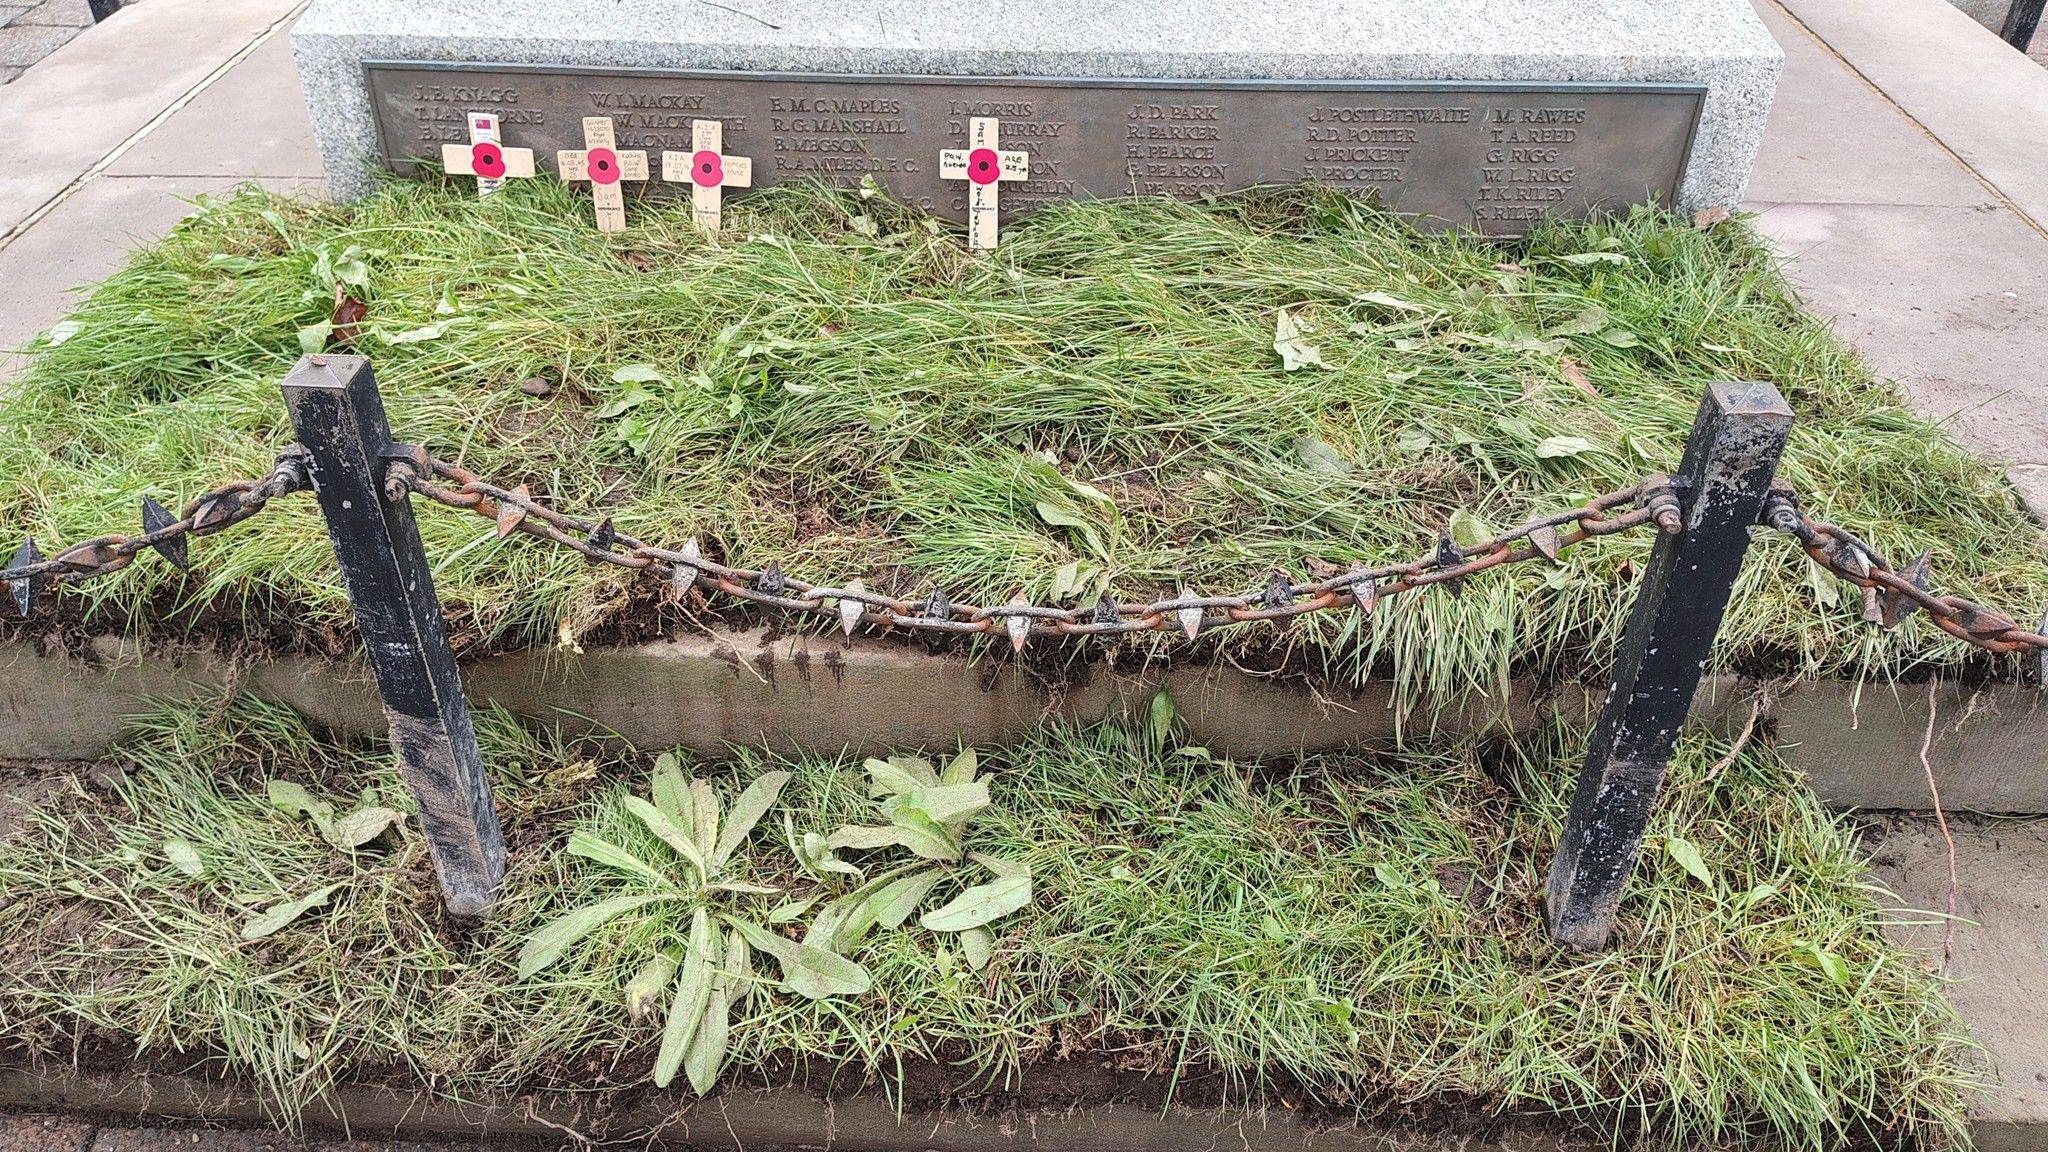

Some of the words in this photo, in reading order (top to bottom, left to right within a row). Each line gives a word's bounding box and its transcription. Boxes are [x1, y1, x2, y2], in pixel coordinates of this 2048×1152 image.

[451, 86, 519, 103] KNAGG
[632, 94, 706, 110] MACKAY
[832, 98, 901, 115] MAPLES
[963, 100, 1033, 117] MORRIS
[1170, 104, 1220, 120] PARK
[433, 106, 545, 125] LANORNE
[640, 113, 749, 131] MACKTH
[1327, 106, 1471, 124] POSTLETHWAITE
[1519, 108, 1586, 124] RAWES
[812, 118, 907, 134] MARSHALL
[998, 121, 1065, 137] URRAY
[1147, 125, 1221, 141] PARKER
[1346, 126, 1418, 143] POTTER
[1525, 128, 1577, 143] REED
[791, 137, 869, 153] MEGSON
[1147, 144, 1215, 160] PEARCE
[1323, 147, 1410, 163] PRICKETT
[1509, 148, 1560, 163] RIGG
[1146, 163, 1229, 179] PEARSON
[1322, 167, 1403, 182] PROCTER
[1526, 168, 1577, 183] RIGG
[1515, 186, 1573, 202] RILEY
[1492, 206, 1547, 221] RILEY
